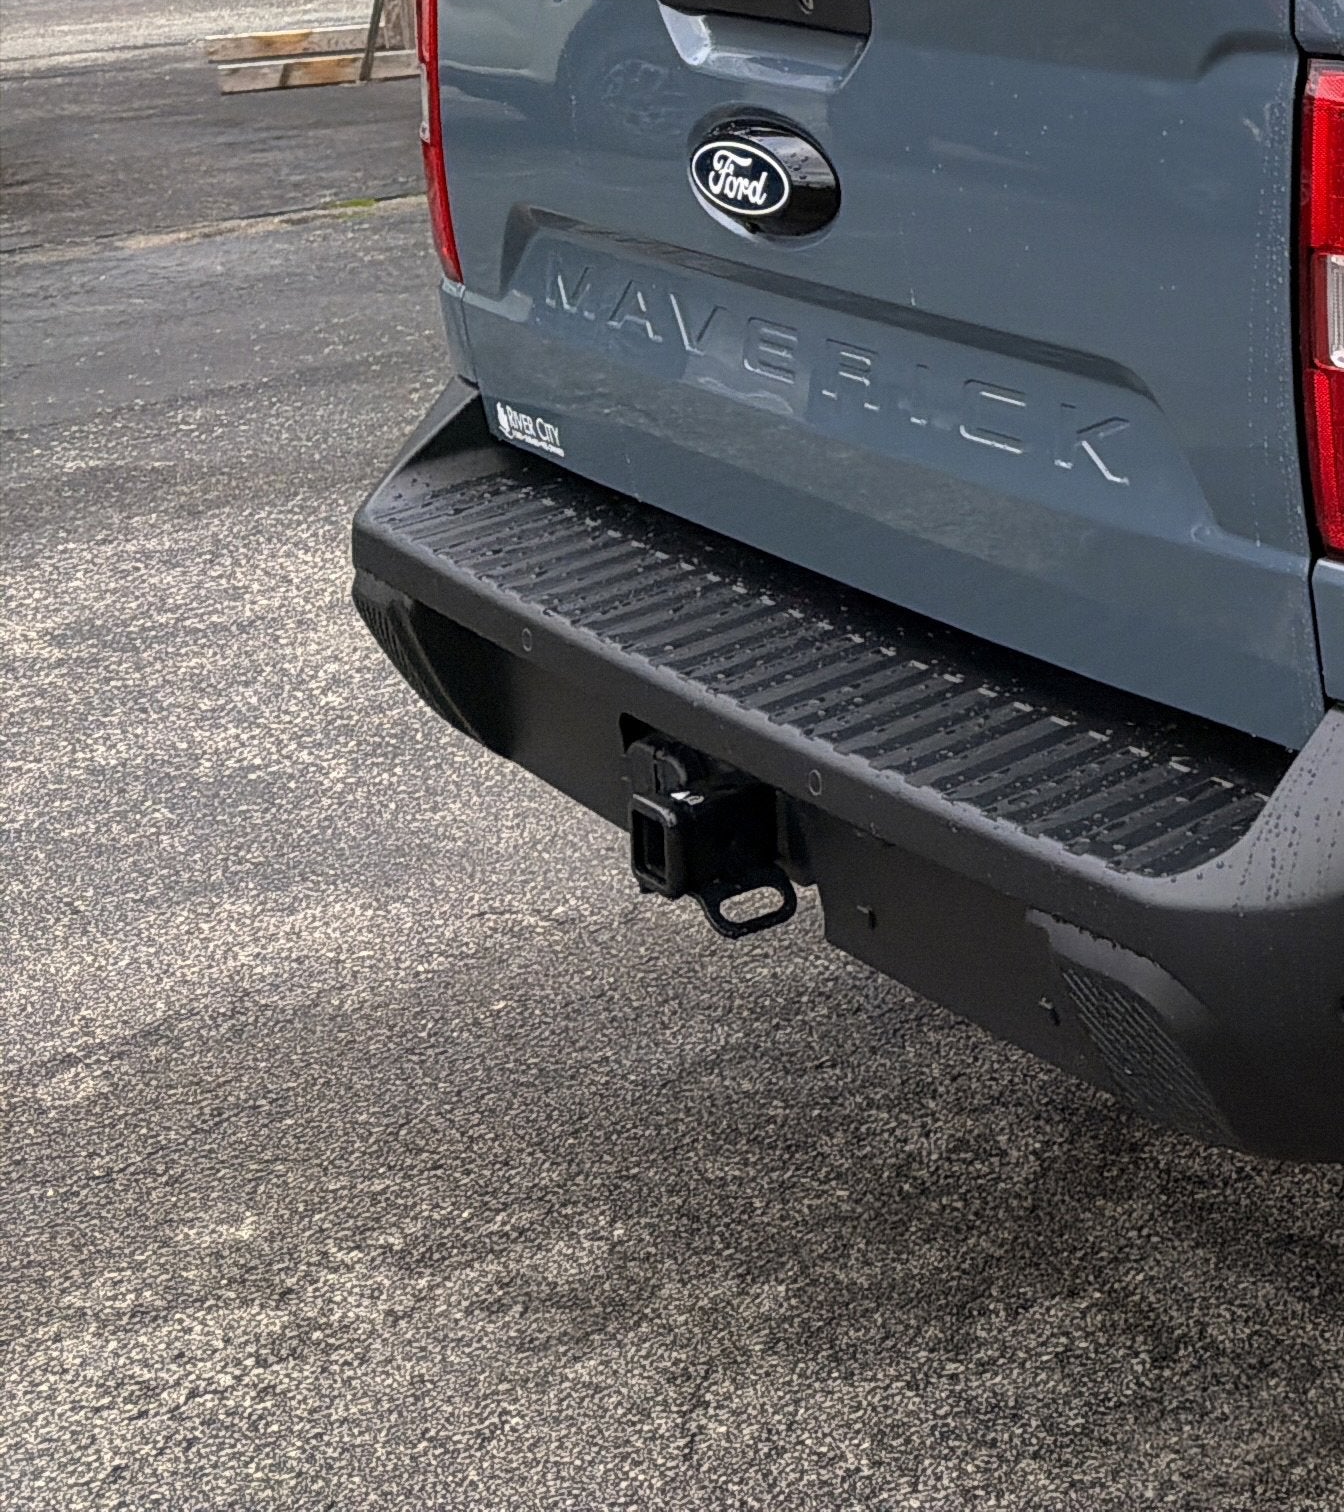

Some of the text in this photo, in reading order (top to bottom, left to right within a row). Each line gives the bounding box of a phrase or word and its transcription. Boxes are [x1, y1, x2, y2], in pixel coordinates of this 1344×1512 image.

[708, 149, 769, 206] Ford
[546, 265, 1131, 486] MAVERICK
[505, 404, 537, 437] RIVER
[536, 417, 560, 446] CITY
